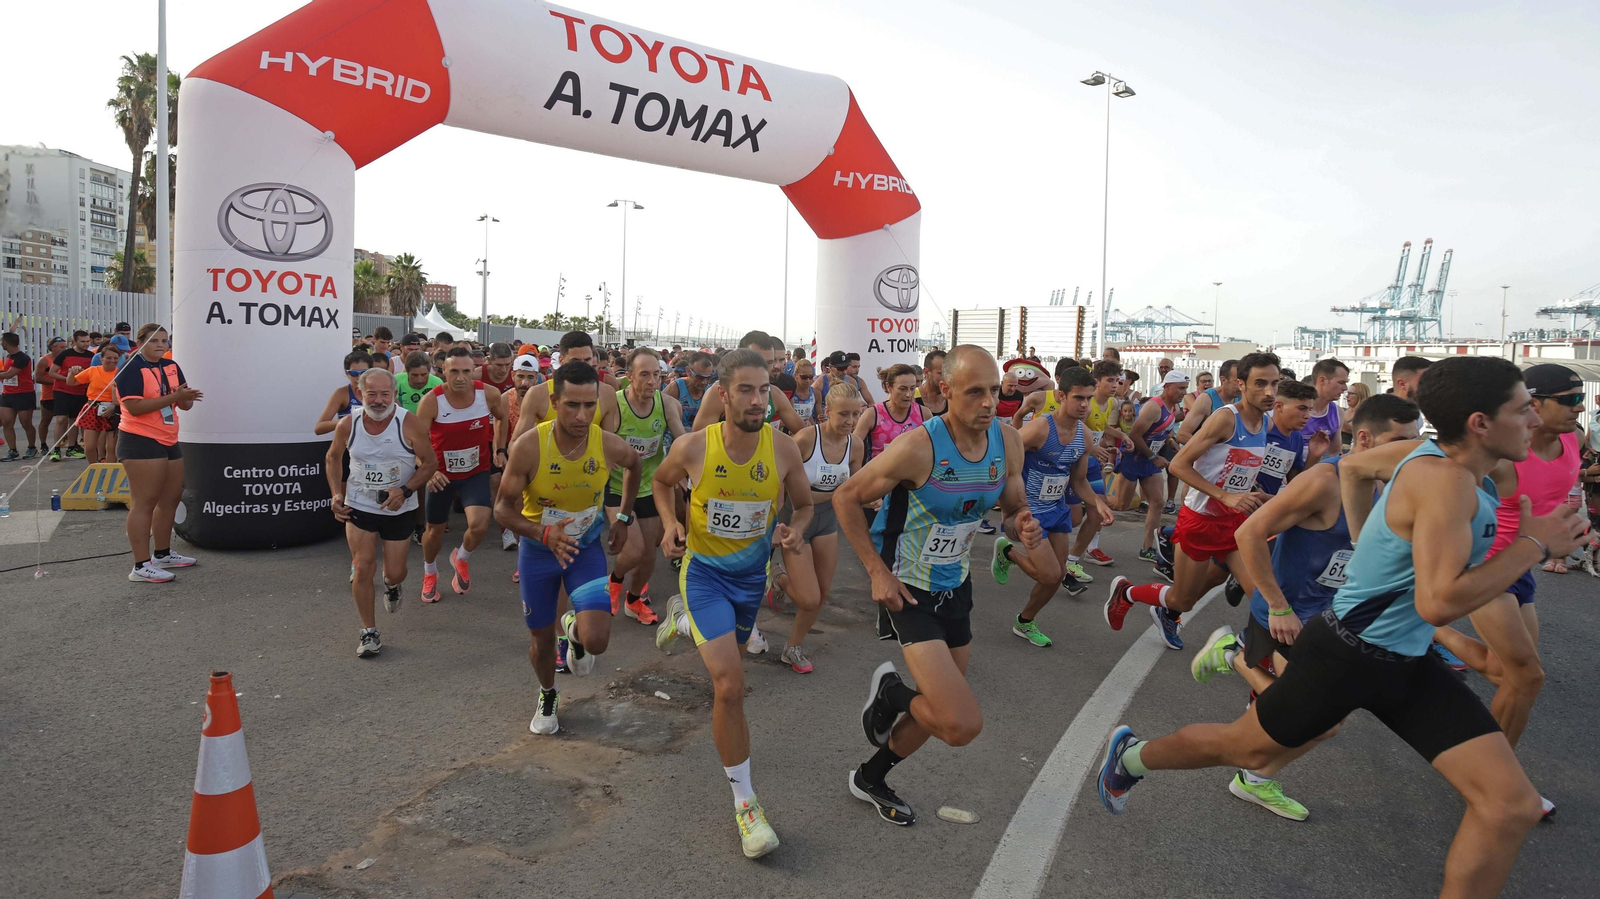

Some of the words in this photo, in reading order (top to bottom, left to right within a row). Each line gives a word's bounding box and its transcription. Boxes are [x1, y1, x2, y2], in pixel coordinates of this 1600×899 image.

[549, 10, 772, 102] TOYOTA
[259, 51, 431, 104] HYBRID
[543, 71, 592, 119] A.
[609, 82, 767, 153] TOMAX
[206, 267, 338, 299] TOYOTA
[206, 301, 233, 325] A.
[239, 302, 339, 329] TOMAX
[866, 317, 919, 334] TOYOT
[867, 338, 885, 353] A.
[448, 458, 466, 467] 576
[1262, 454, 1283, 469] 555
[223, 466, 275, 479] Centro
[278, 463, 320, 478] Oficial
[365, 471, 384, 483] 422
[820, 474, 838, 485] 953
[1228, 474, 1248, 487] 620
[243, 482, 302, 496] TOYOTA
[1047, 485, 1063, 494] 812
[202, 501, 269, 517] Algeciras
[271, 503, 281, 515] y
[712, 512, 741, 529] 562
[928, 538, 957, 553] 371
[1329, 562, 1346, 578] 61
